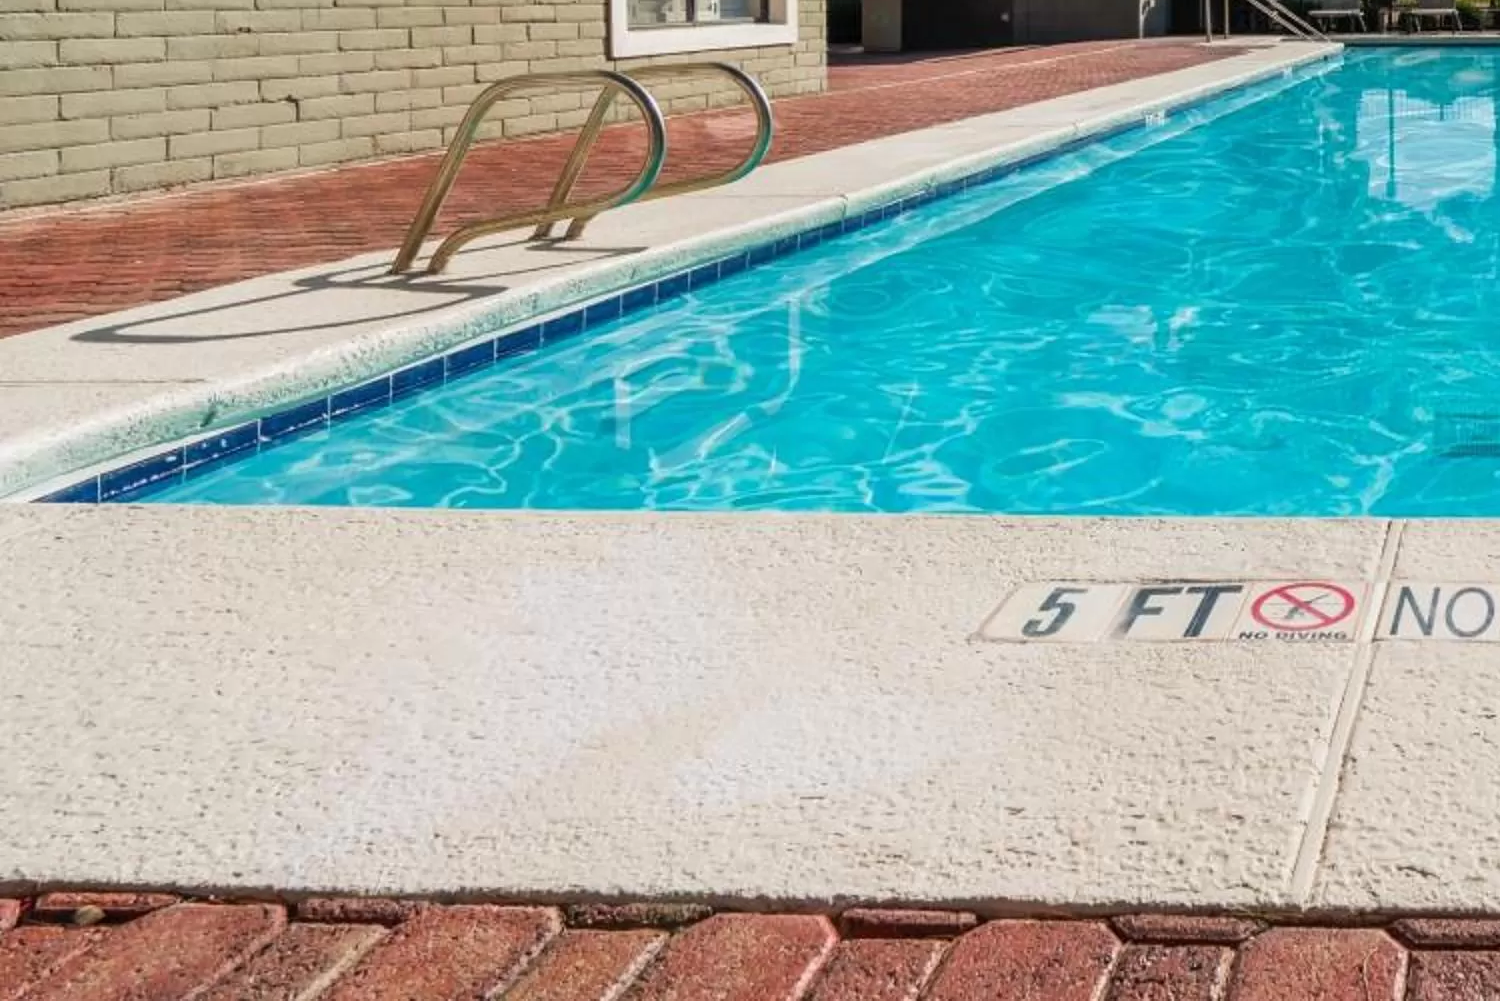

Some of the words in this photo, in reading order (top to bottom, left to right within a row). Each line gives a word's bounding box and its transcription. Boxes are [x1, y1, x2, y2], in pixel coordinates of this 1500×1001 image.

[1021, 586, 1088, 638] 5
[1112, 584, 1243, 638] FT
[1238, 630, 1273, 640] NO
[1275, 630, 1349, 640] DIVING
[1389, 585, 1496, 639] NO
